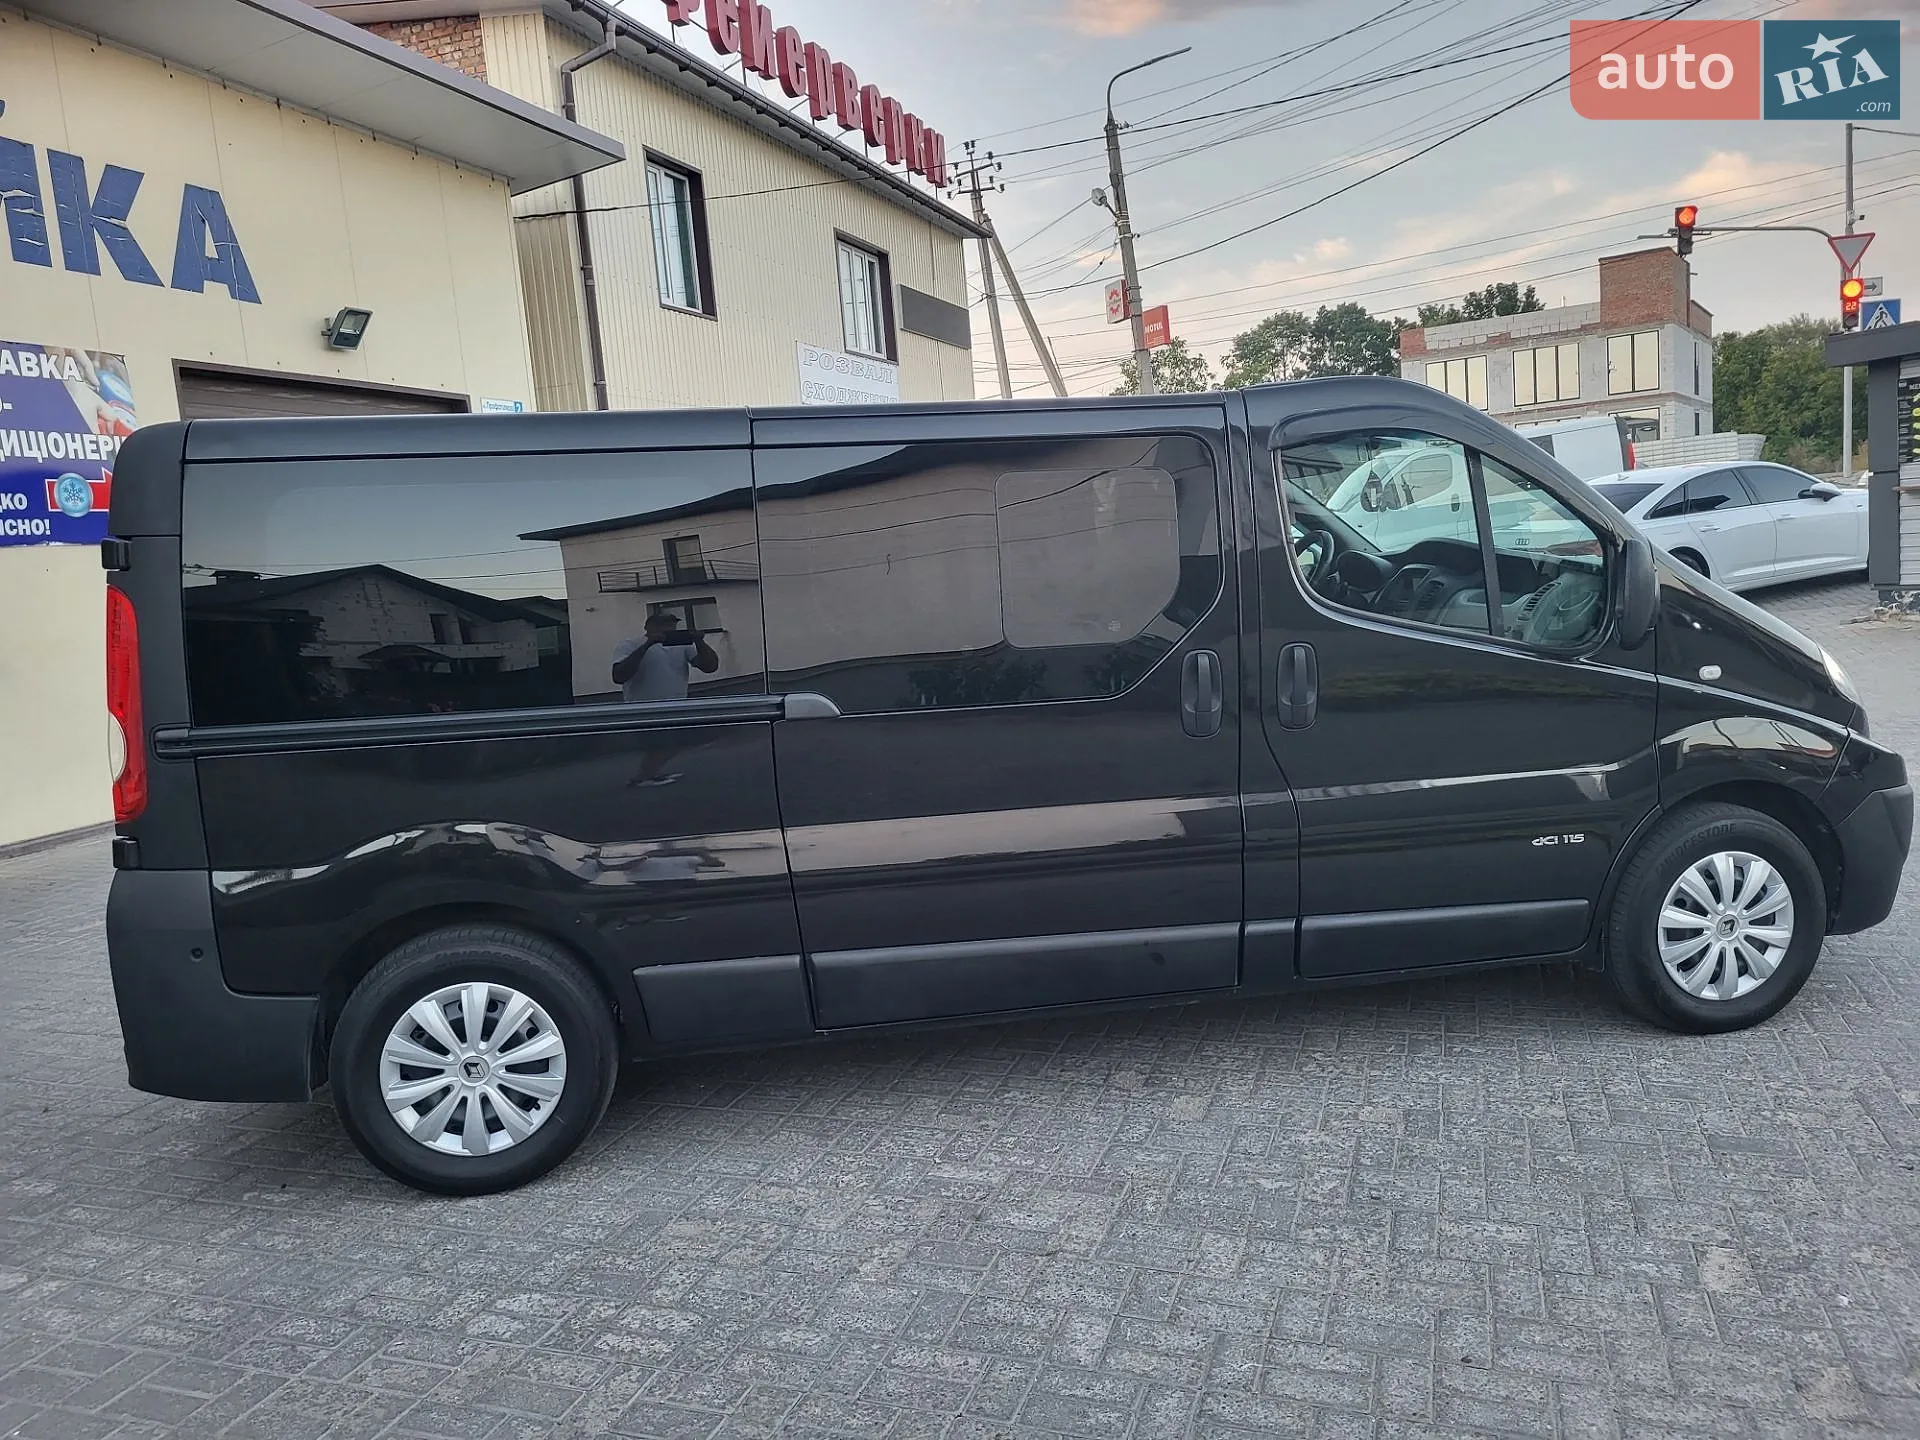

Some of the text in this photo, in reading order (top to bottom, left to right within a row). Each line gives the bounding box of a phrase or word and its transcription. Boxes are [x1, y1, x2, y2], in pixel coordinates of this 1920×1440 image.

[1845, 301, 1857, 311] 22
[1144, 322, 1163, 334] MOTUL
[0, 349, 84, 382] АВКА
[803, 349, 893, 384] РОЗВАЛ
[0, 493, 28, 513] КО
[1562, 833, 1585, 844] 115
